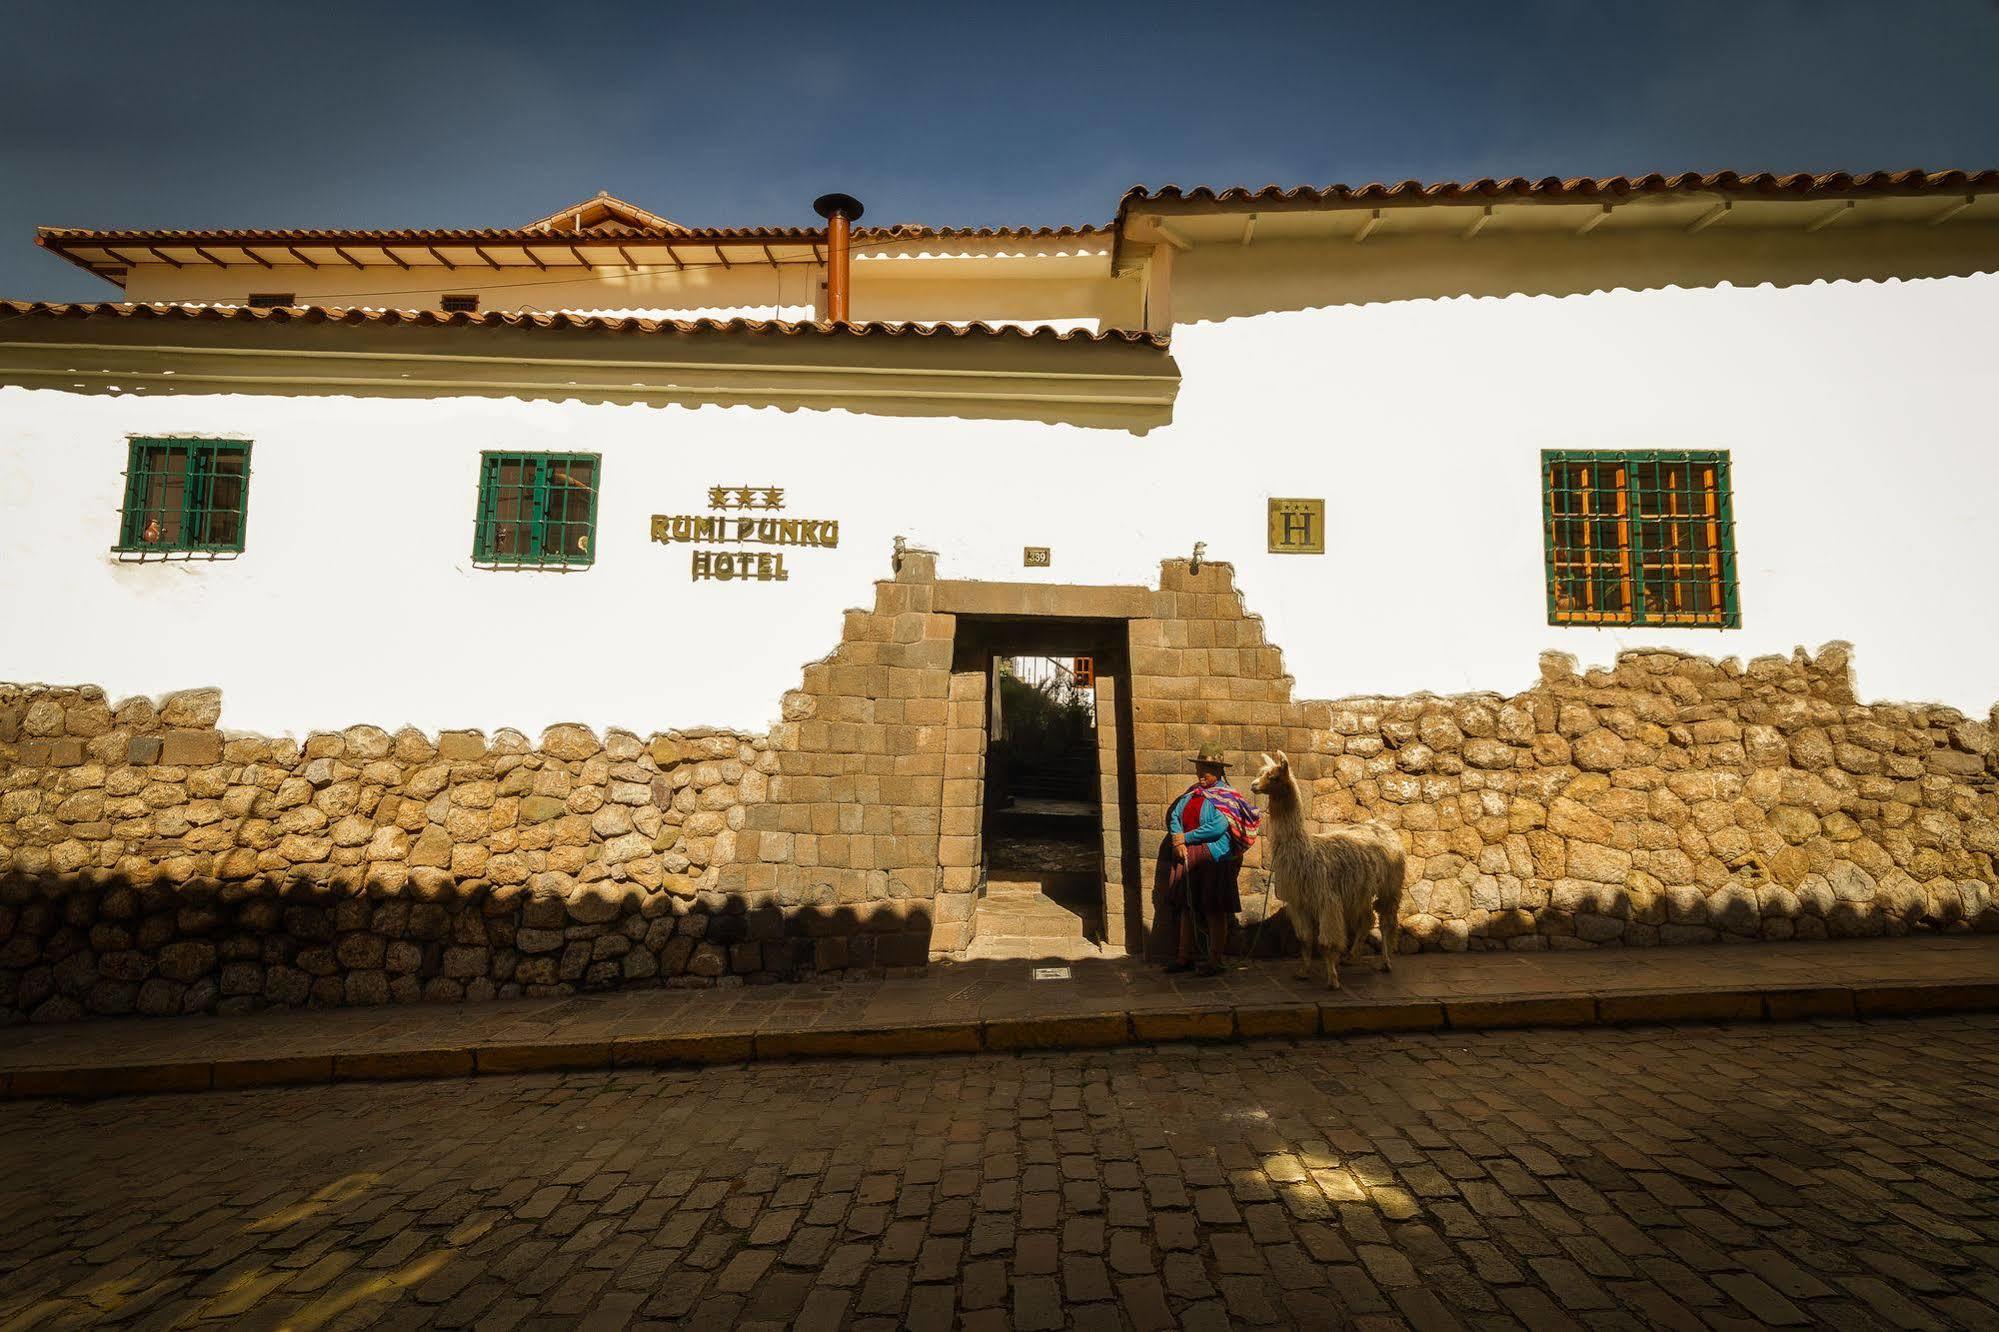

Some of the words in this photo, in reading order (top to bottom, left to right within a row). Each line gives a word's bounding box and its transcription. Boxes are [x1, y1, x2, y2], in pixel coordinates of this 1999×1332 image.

[651, 514, 726, 545] RUMI
[737, 517, 839, 548] PUNKU
[1280, 512, 1315, 545] H
[692, 550, 789, 582] HOTEL
